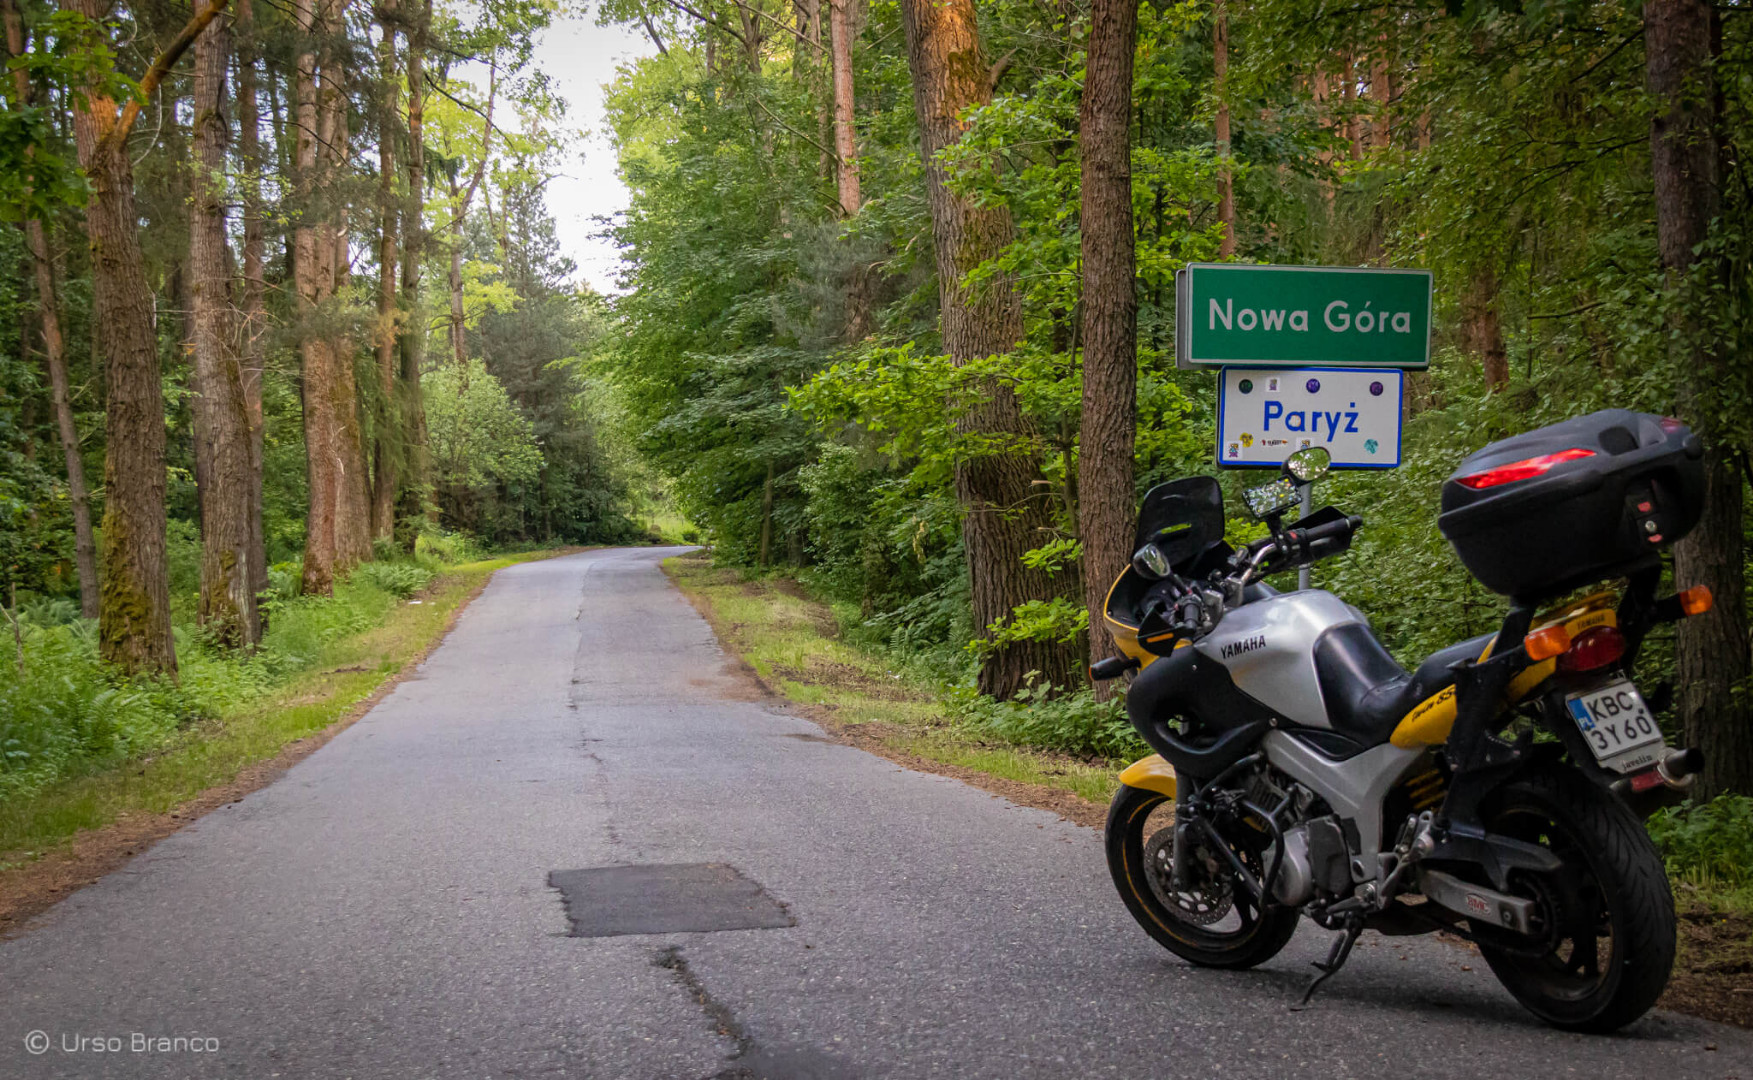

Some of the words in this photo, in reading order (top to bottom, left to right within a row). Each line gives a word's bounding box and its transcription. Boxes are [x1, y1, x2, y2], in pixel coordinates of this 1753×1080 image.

[1209, 298, 1309, 332] Nowa
[1324, 300, 1411, 333] Góra
[1263, 400, 1359, 442] Paryż
[1220, 635, 1266, 659] YAMAHA
[1587, 691, 1633, 722] KBC
[1591, 715, 1652, 750] 3Y60
